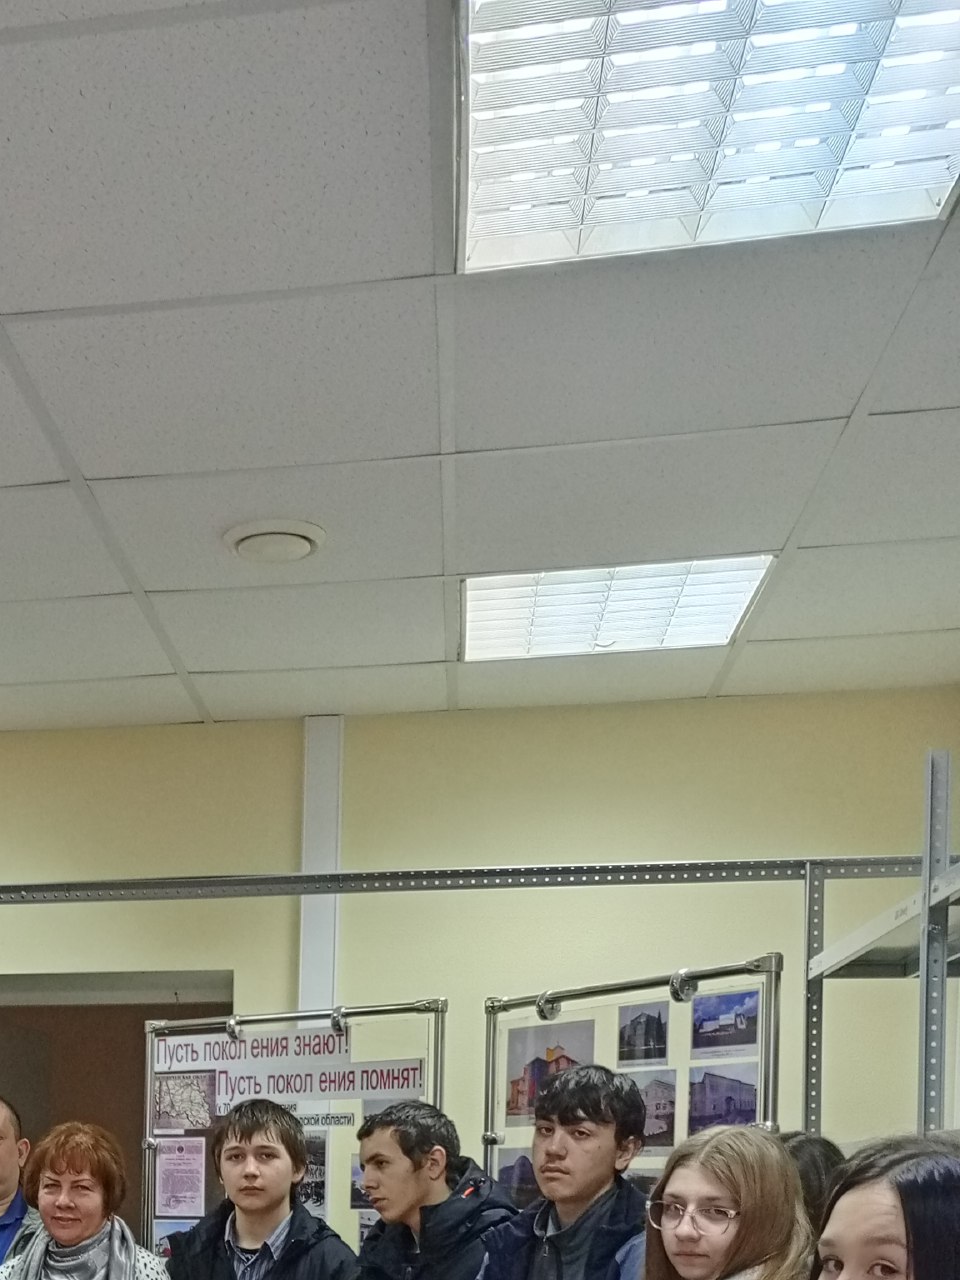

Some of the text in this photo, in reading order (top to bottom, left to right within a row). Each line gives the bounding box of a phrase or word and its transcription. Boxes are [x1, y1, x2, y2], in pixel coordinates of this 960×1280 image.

[156, 1038, 199, 1070] Пусть
[293, 1026, 349, 1057] знают!
[217, 1070, 262, 1101] Пусть
[360, 1060, 423, 1090] помнят!
[320, 1112, 355, 1126] области)
